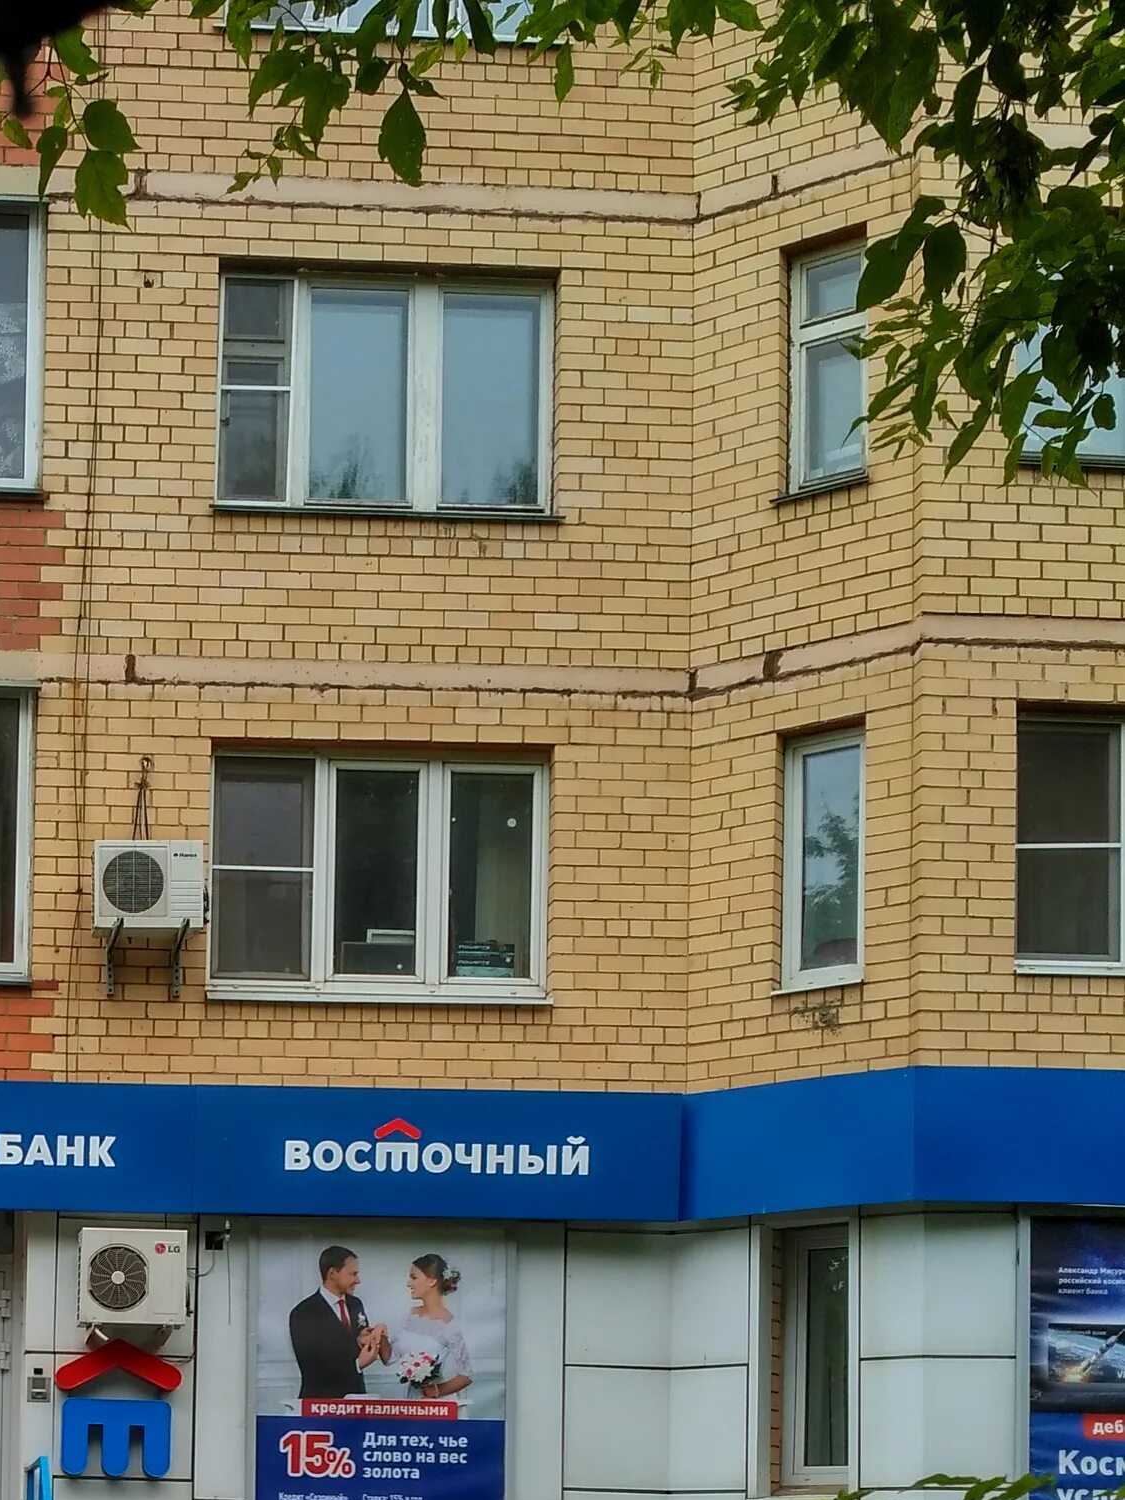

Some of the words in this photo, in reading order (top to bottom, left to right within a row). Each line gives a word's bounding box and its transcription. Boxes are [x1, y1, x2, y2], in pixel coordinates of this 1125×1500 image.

[284, 1135, 590, 1176] ВОСТОЧНЫЙ
[167, 1245, 181, 1254] LG
[310, 1402, 363, 1416] кредит
[365, 1403, 449, 1416] наличными
[362, 1432, 397, 1448] Для
[400, 1434, 435, 1449] тех,
[438, 1434, 469, 1448] чье
[280, 1430, 355, 1478] 15%
[362, 1450, 412, 1463] слово
[415, 1451, 436, 1464] на
[439, 1452, 468, 1464] вес
[362, 1467, 421, 1480] золота
